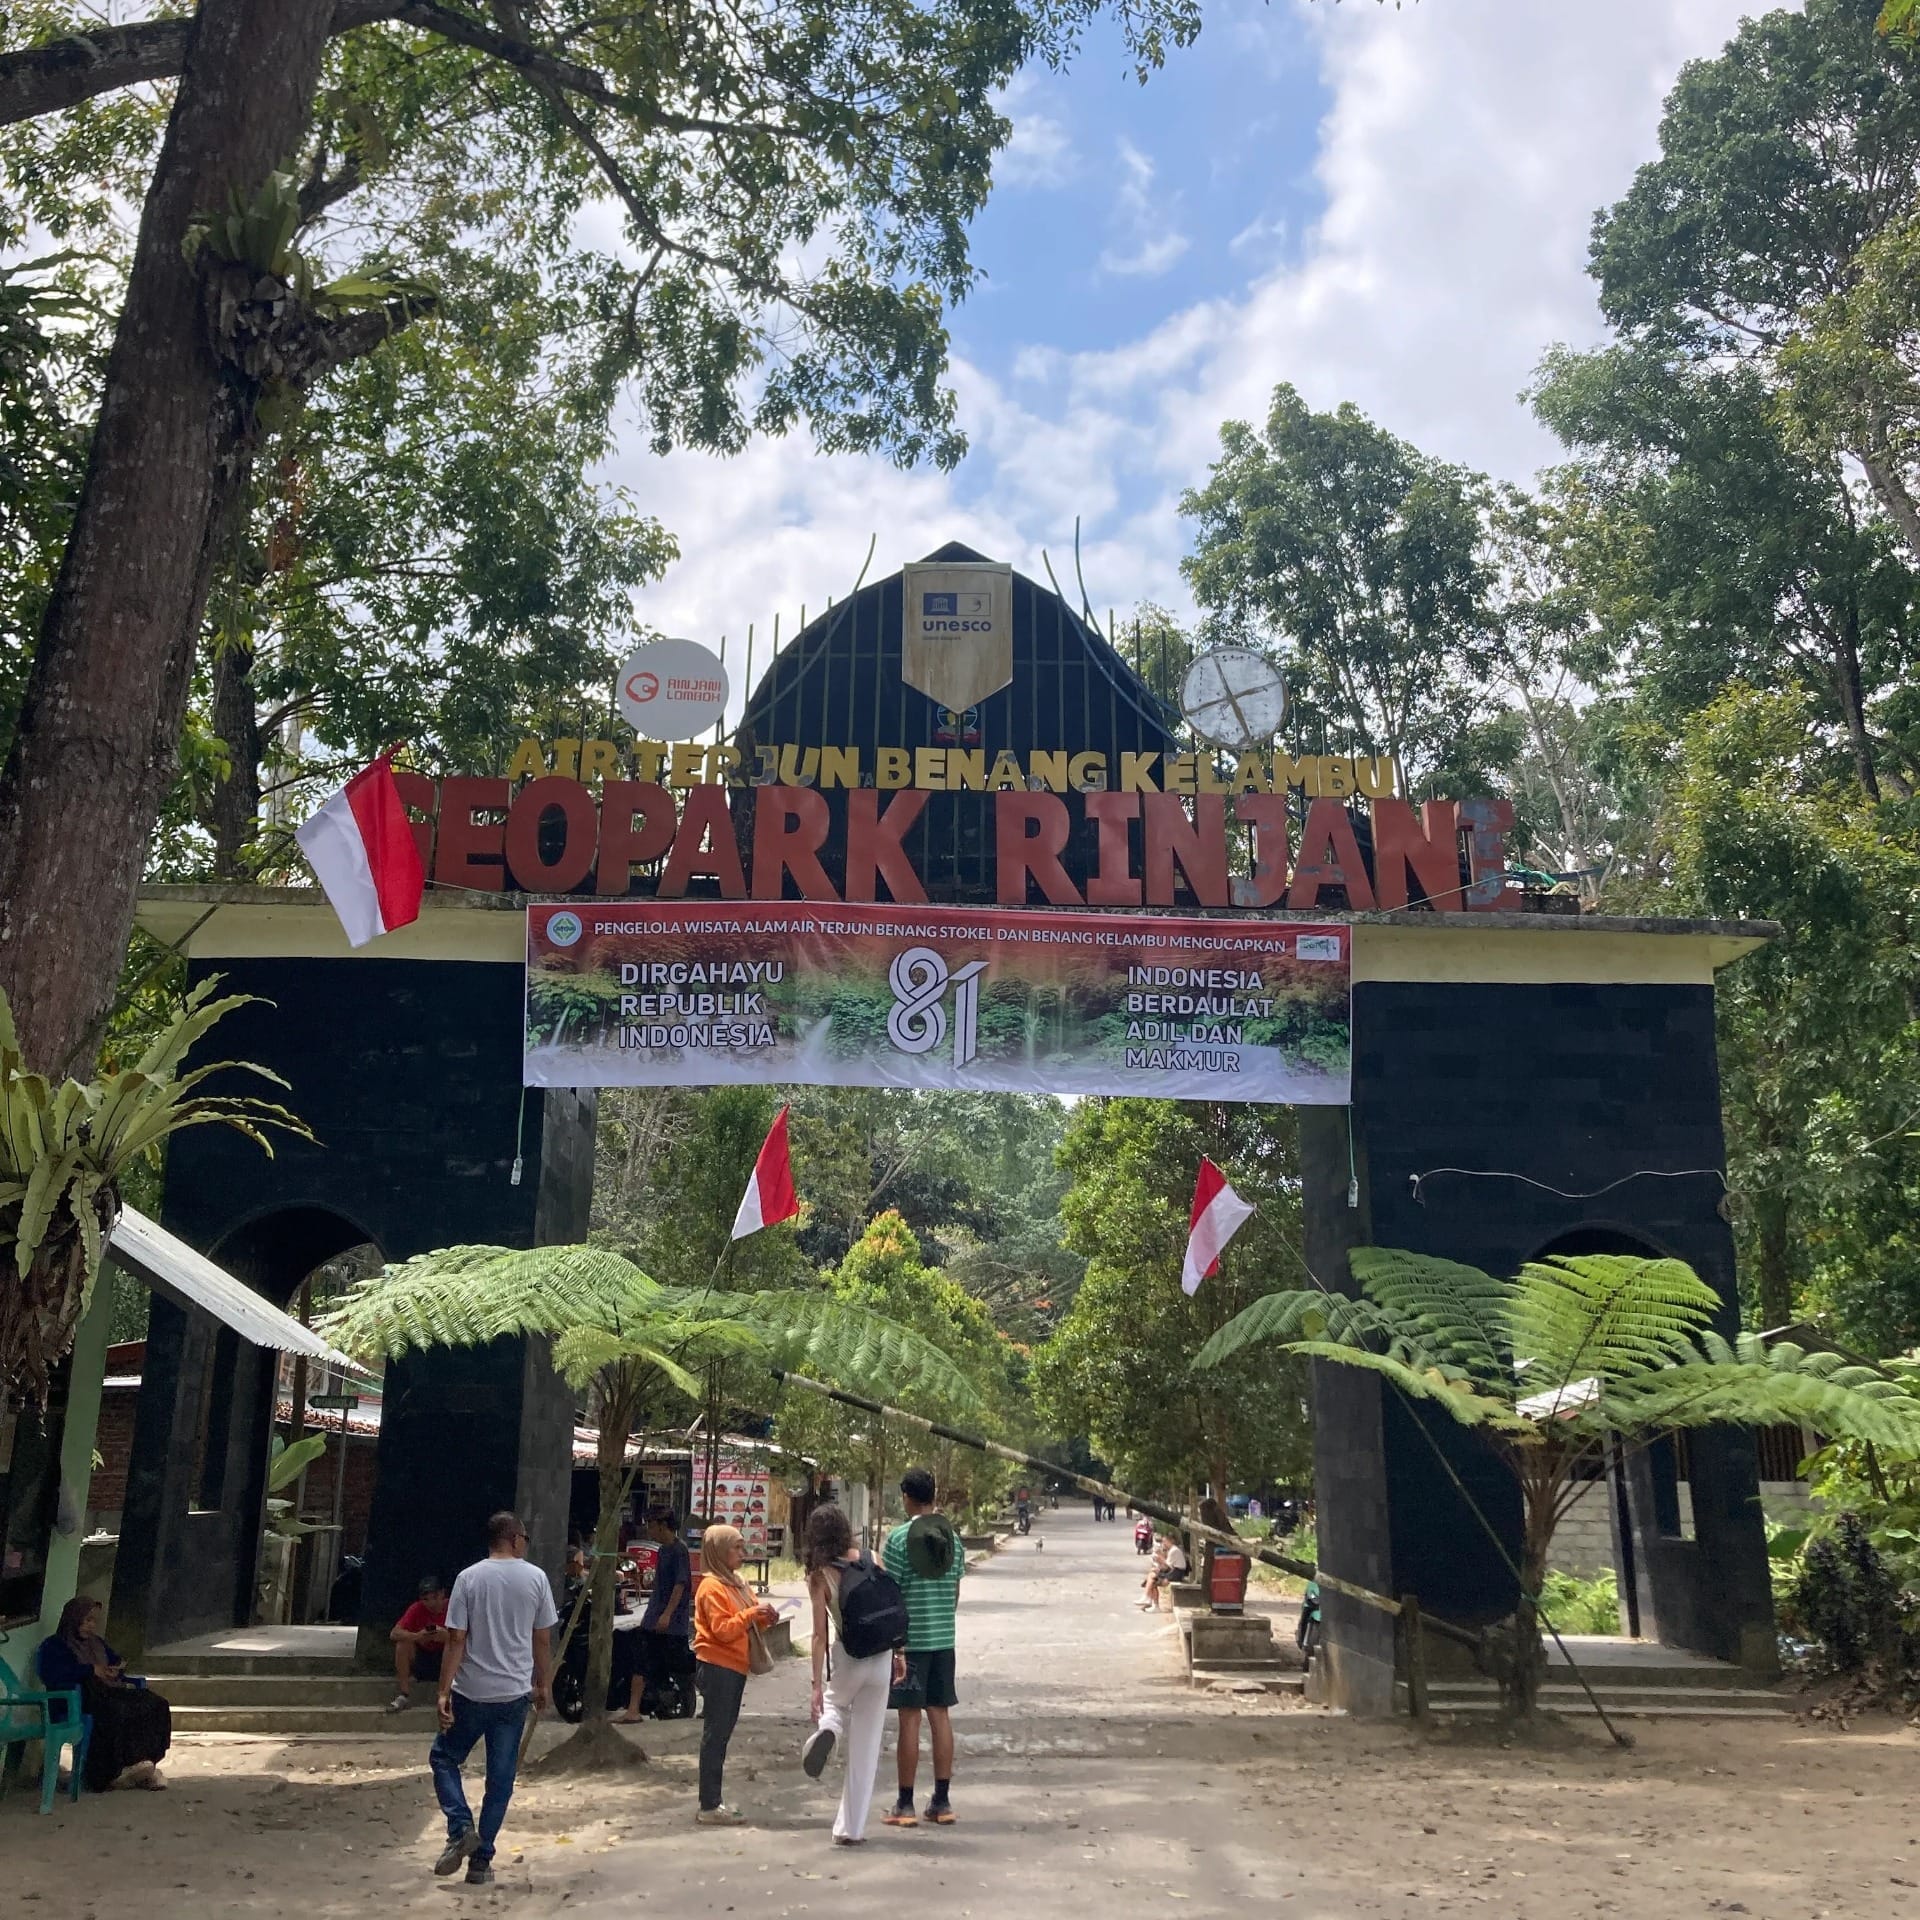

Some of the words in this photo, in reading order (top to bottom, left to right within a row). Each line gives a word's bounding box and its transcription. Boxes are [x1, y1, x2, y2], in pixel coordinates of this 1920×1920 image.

[922, 620, 992, 632] unesco
[509, 738, 619, 782] AIR
[630, 741, 860, 790] TERJUN
[876, 746, 1107, 793] BENANG
[1120, 751, 1395, 799] KELAMBU
[996, 791, 1522, 912] RINJANI
[594, 921, 681, 935] PENGELOLA
[685, 921, 740, 934] WISATA
[745, 920, 788, 934] ALAM
[791, 920, 815, 933] AIR
[818, 921, 873, 936] TERJUN
[876, 923, 937, 938] BENANG
[940, 925, 993, 940] STOKEL
[997, 928, 1029, 942] DAN
[1032, 929, 1093, 945] BENANG
[1095, 932, 1167, 948] KELAMBU
[1169, 936, 1286, 953] MENGUCAPKAN
[621, 961, 784, 986] DIRGAHAYU
[1127, 966, 1264, 991] INDONESIA
[619, 993, 763, 1017] REPUBLIK
[887, 947, 991, 1071] 81
[1127, 993, 1274, 1019] BERDAULAT
[618, 1024, 776, 1049] INDONESIA
[1126, 1021, 1185, 1043] ADIL
[1190, 1024, 1243, 1045] DAN
[1125, 1047, 1241, 1073] MAKMUR
